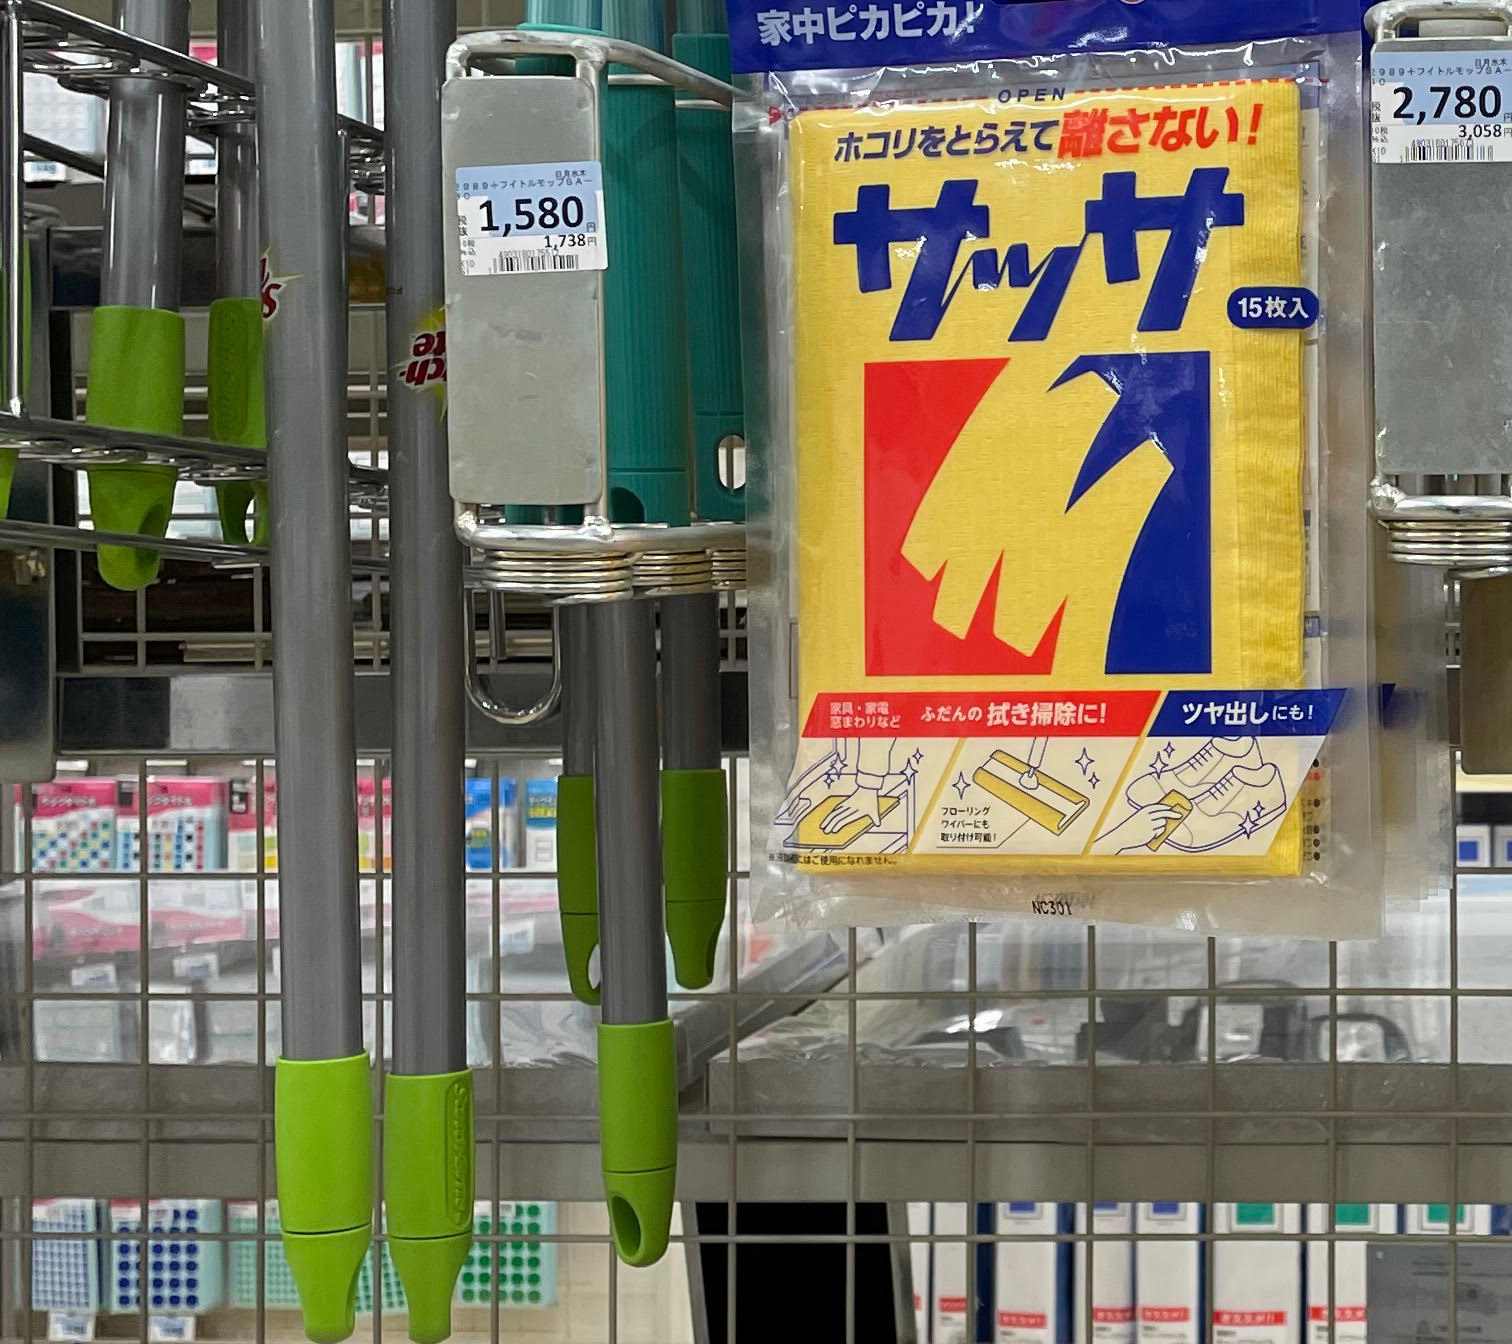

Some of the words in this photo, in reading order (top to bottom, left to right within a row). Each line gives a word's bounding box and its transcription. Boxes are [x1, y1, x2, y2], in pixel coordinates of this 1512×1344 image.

[757, 2, 977, 45] 家中ピカピカ!
[997, 87, 1068, 104] OPEN
[833, 167, 1246, 342] サッサ
[1237, 296, 1309, 319] 15枚入
[829, 701, 890, 716] 家具・家電
[829, 715, 901, 730] 窓まわりなど
[941, 806, 991, 817] フローリング
[941, 818, 990, 830] ワイパーにも
[940, 831, 998, 844] 取り付け可能!
